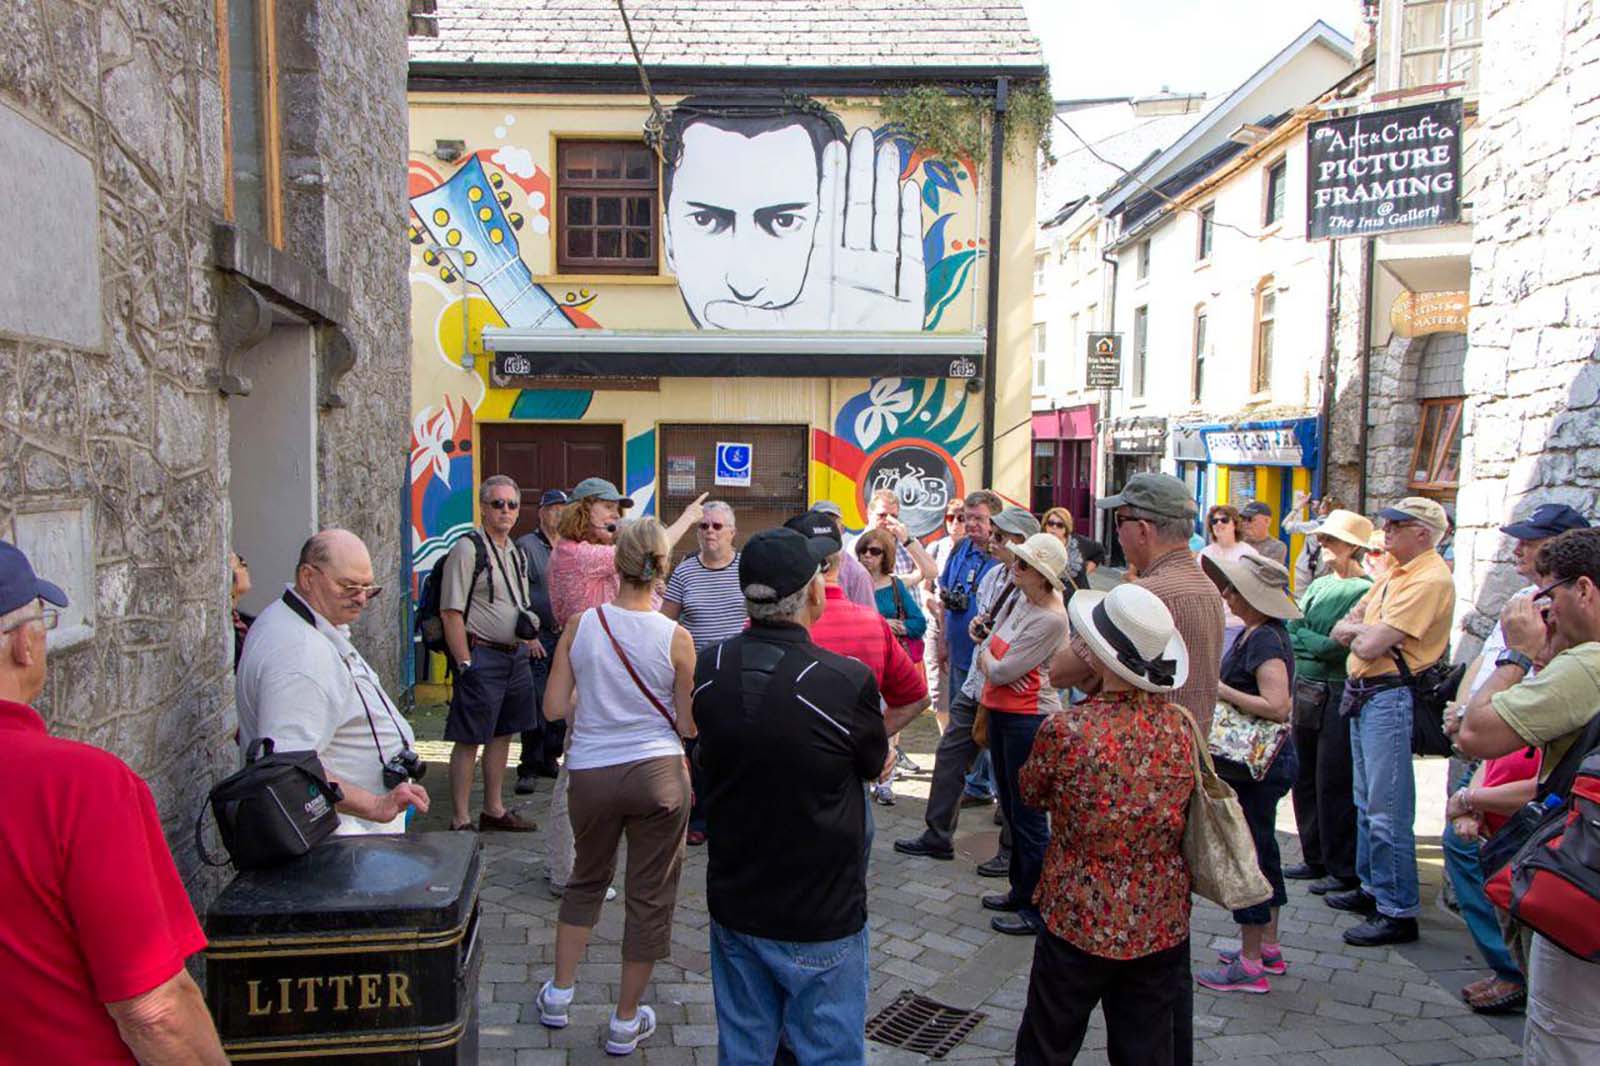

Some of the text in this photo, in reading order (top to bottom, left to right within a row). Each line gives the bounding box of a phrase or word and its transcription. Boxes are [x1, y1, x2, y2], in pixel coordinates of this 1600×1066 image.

[1318, 145, 1450, 182] PICTURE
[1314, 172, 1454, 208] FRAMING
[1329, 216, 1354, 229] The
[1388, 204, 1441, 226] Gallery
[1377, 201, 1394, 216] @
[248, 972, 413, 1016] LITTER
